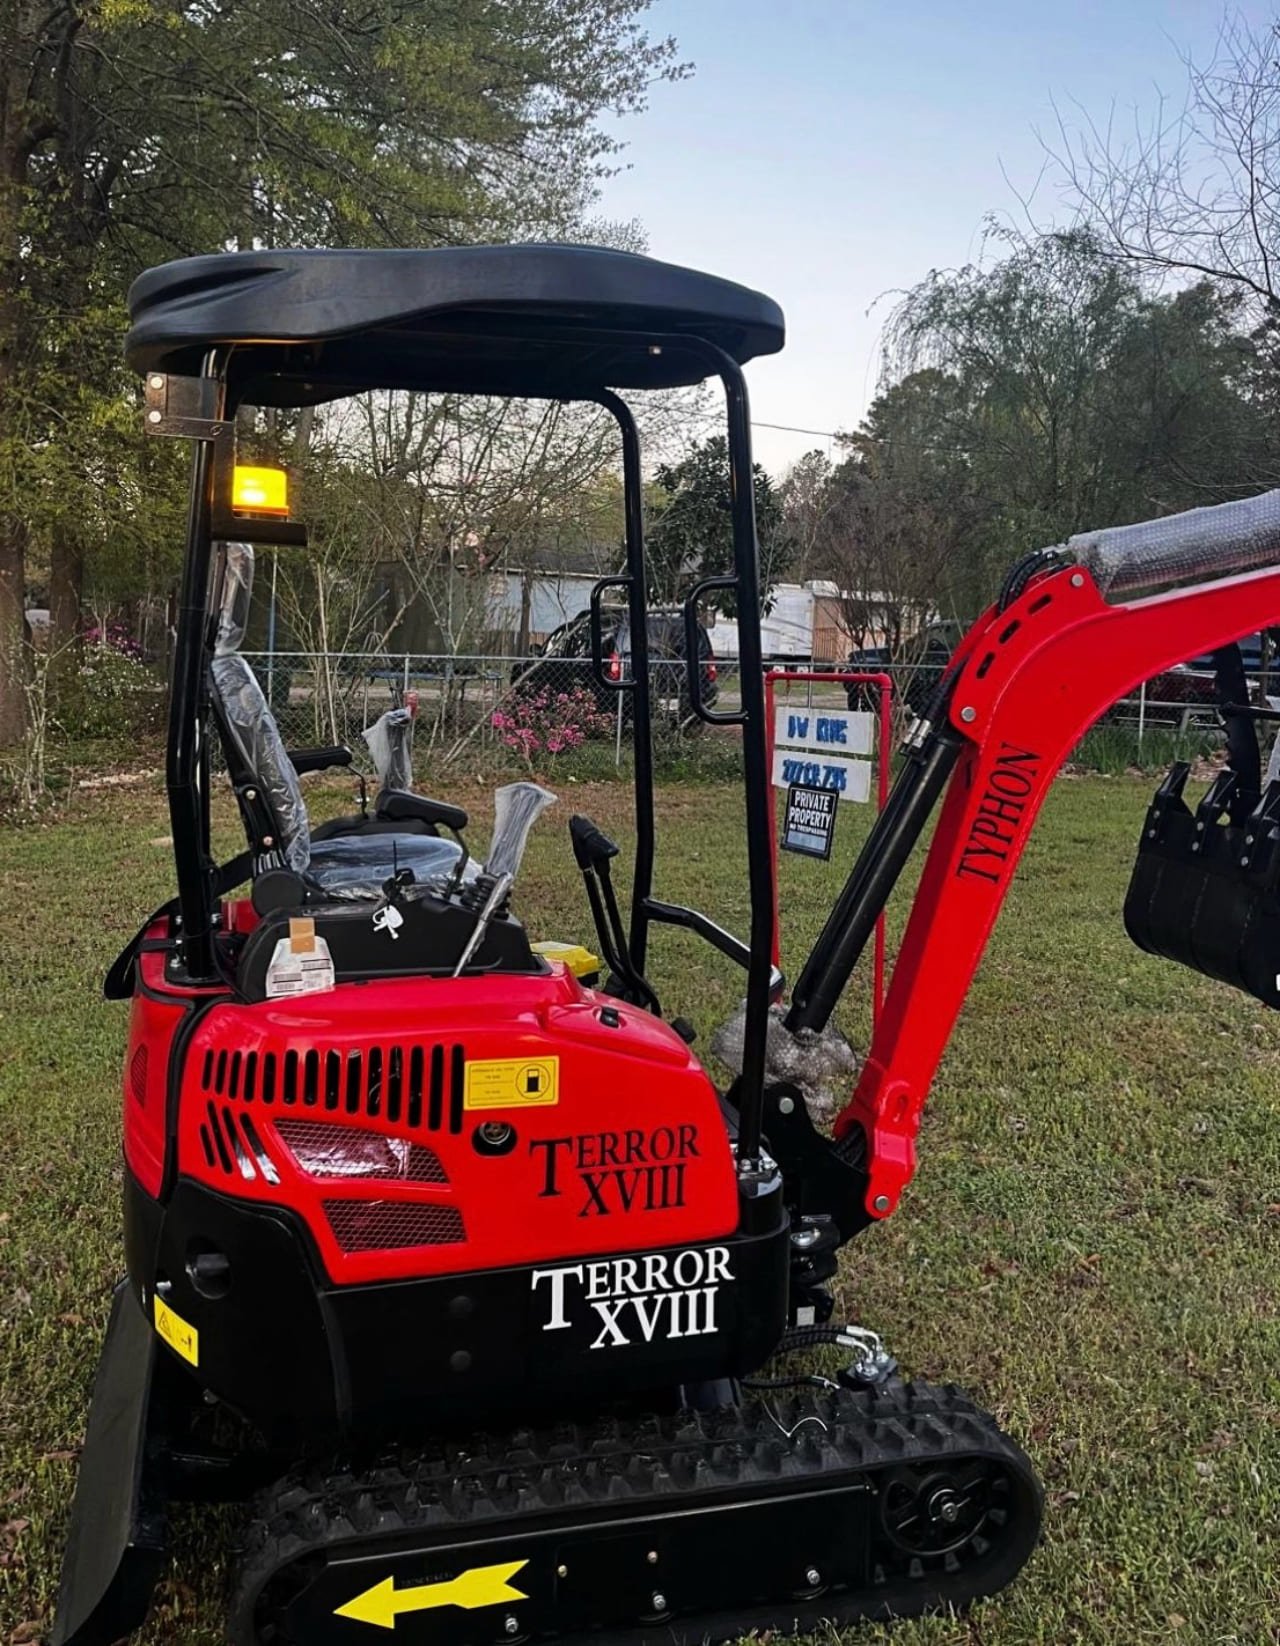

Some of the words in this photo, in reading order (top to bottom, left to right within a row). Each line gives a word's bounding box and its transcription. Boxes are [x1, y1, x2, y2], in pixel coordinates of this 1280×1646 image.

[789, 807, 832, 829] PROPERTY
[794, 791, 830, 811] PRIVATE
[956, 741, 1042, 884] TYPHON
[529, 1125, 700, 1197] TERROR
[578, 1163, 688, 1218] XVIII
[531, 1246, 736, 1330] TERROR
[590, 1286, 719, 1349] XVIII
